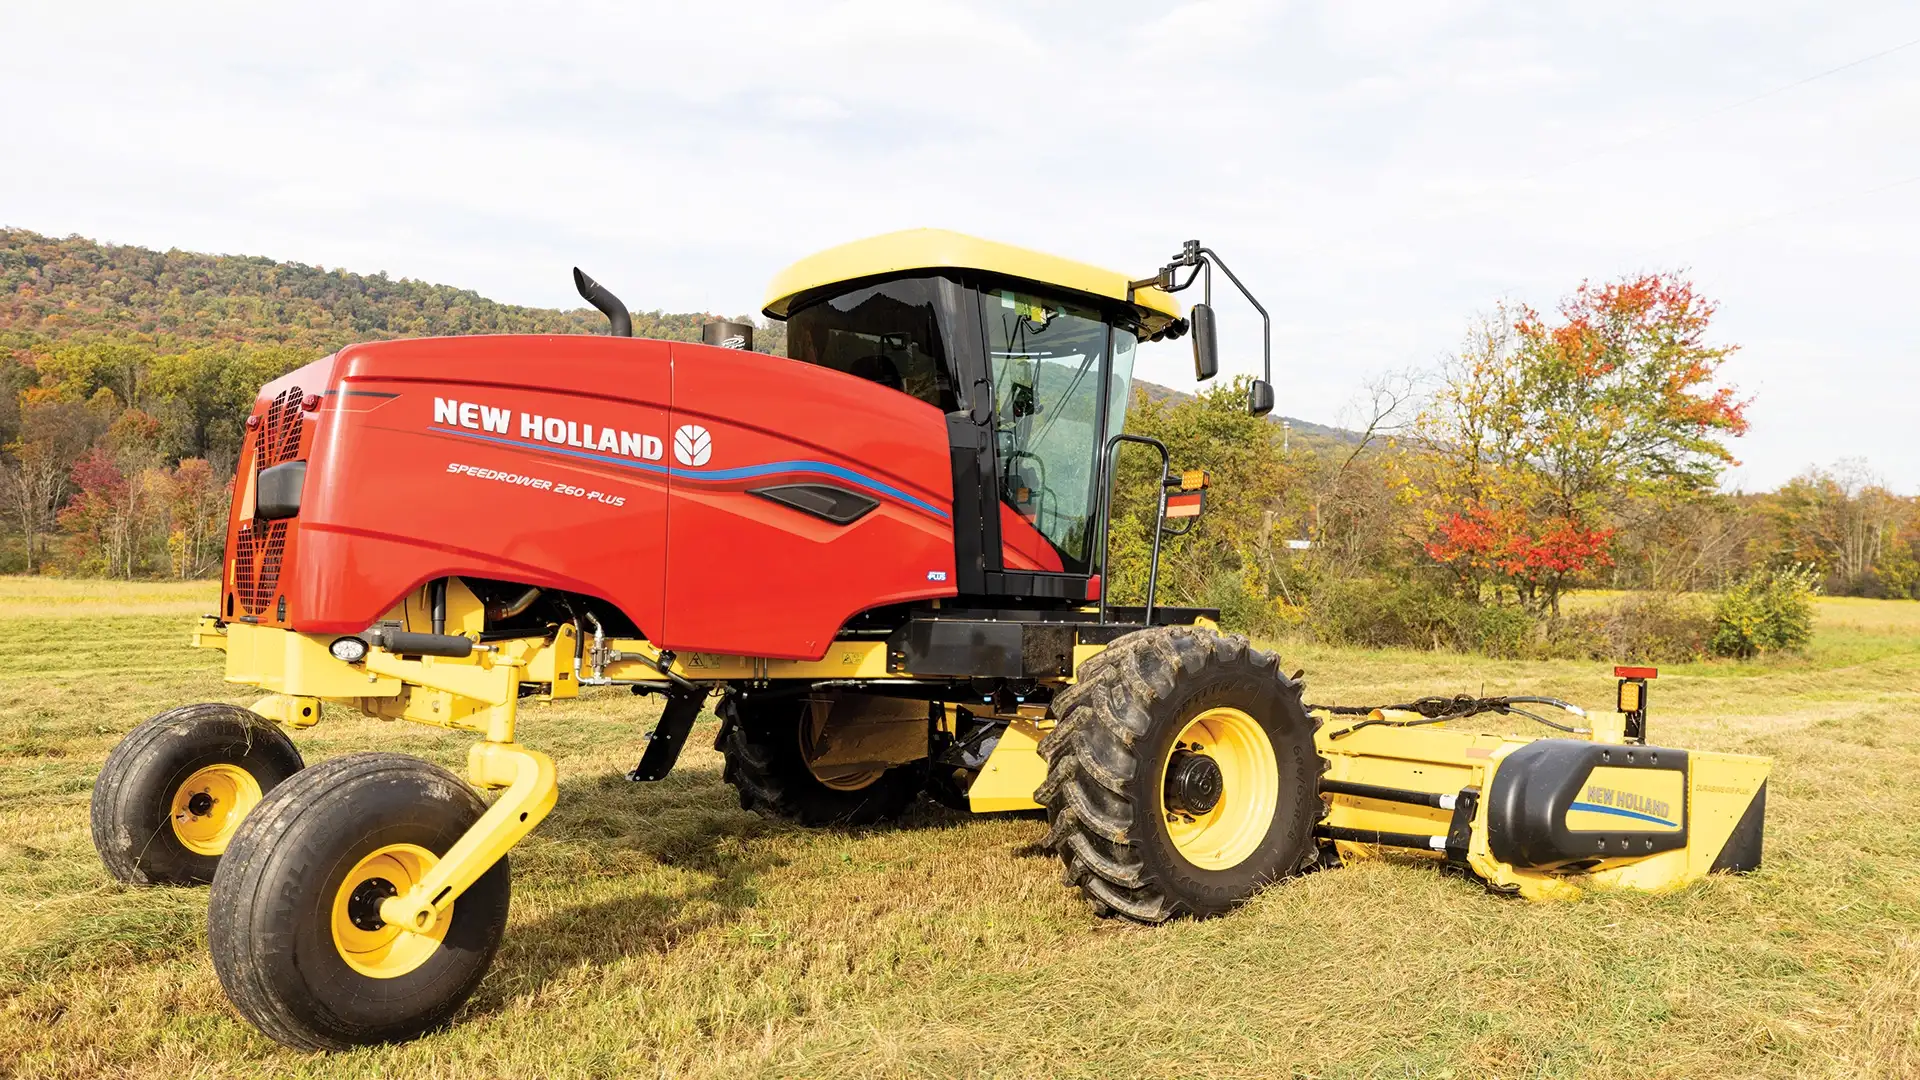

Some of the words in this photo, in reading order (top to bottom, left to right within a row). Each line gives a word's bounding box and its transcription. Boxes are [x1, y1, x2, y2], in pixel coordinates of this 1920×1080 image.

[434, 397, 511, 434] NEW
[519, 412, 663, 460] HOLLAND
[446, 463, 552, 490] SPEEDROWER
[553, 483, 585, 498] 260
[1587, 785, 1614, 805] NEW
[1616, 791, 1669, 818] HOLLAND
